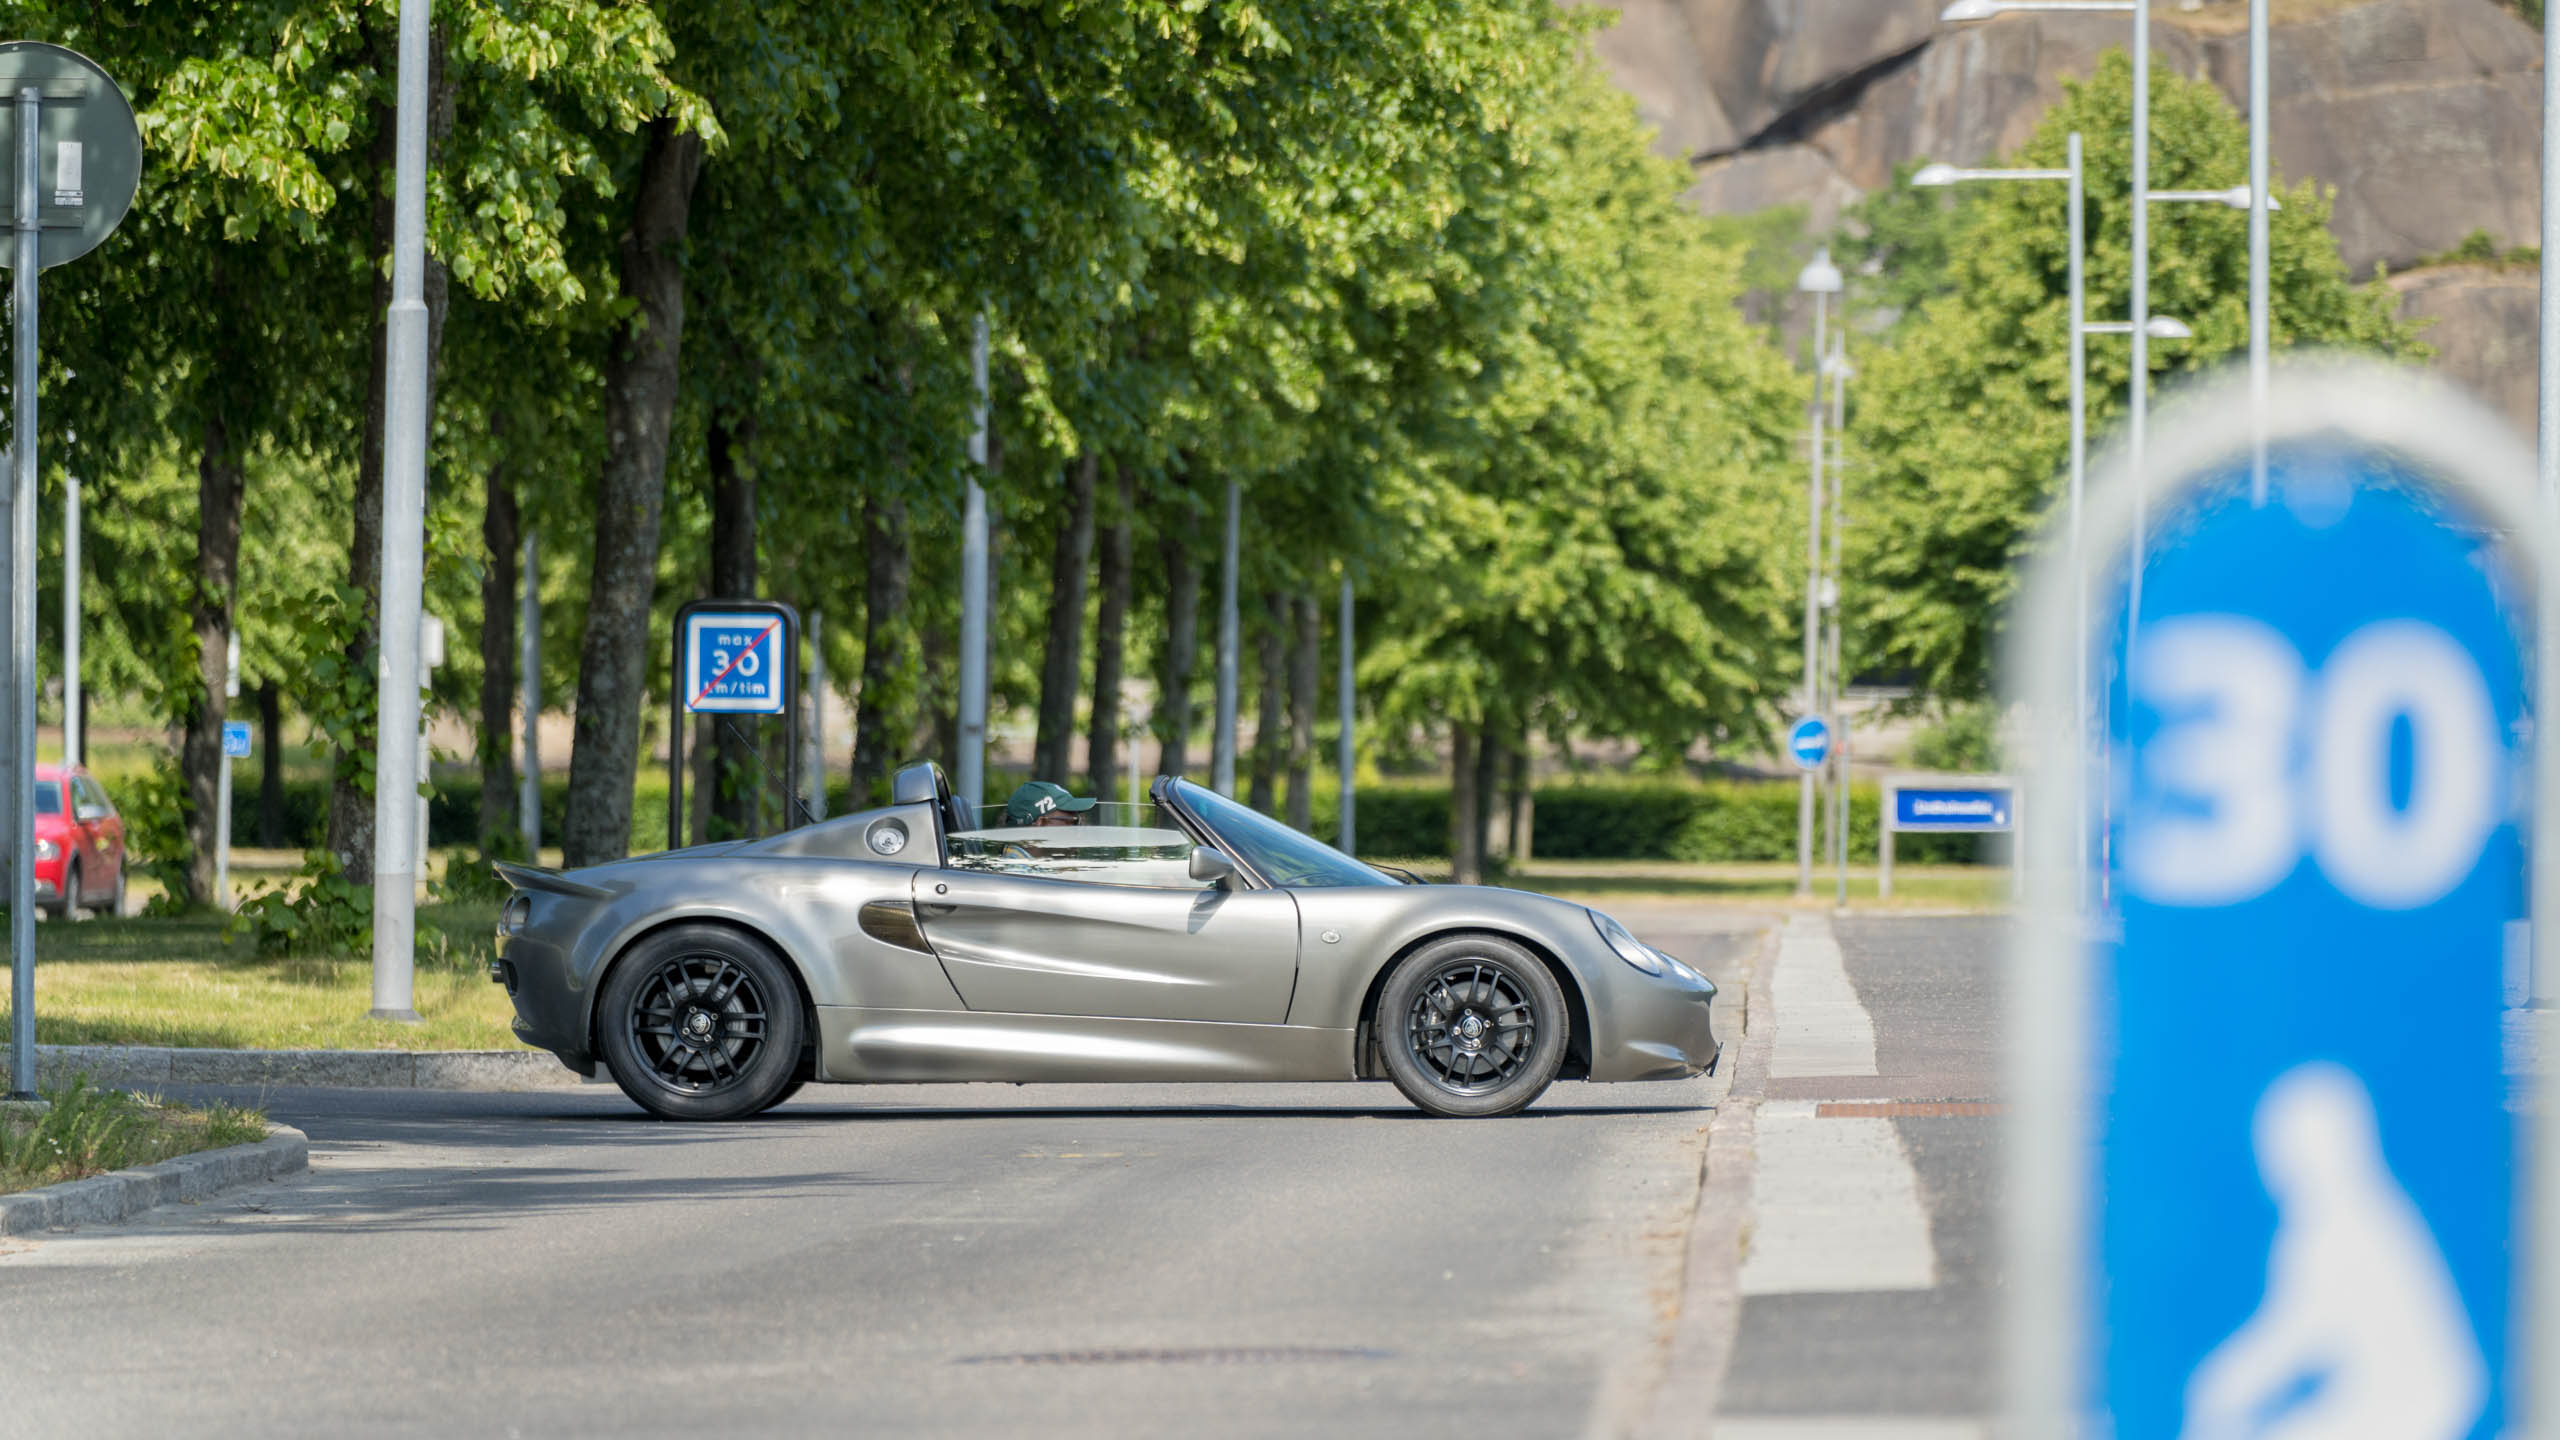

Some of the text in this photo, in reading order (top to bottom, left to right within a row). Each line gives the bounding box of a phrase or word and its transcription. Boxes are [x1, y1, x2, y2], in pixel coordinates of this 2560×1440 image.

[718, 634, 753, 646] max
[712, 649, 760, 677] 30
[2122, 614, 2501, 908] 30
[1034, 796, 1056, 814] 72
